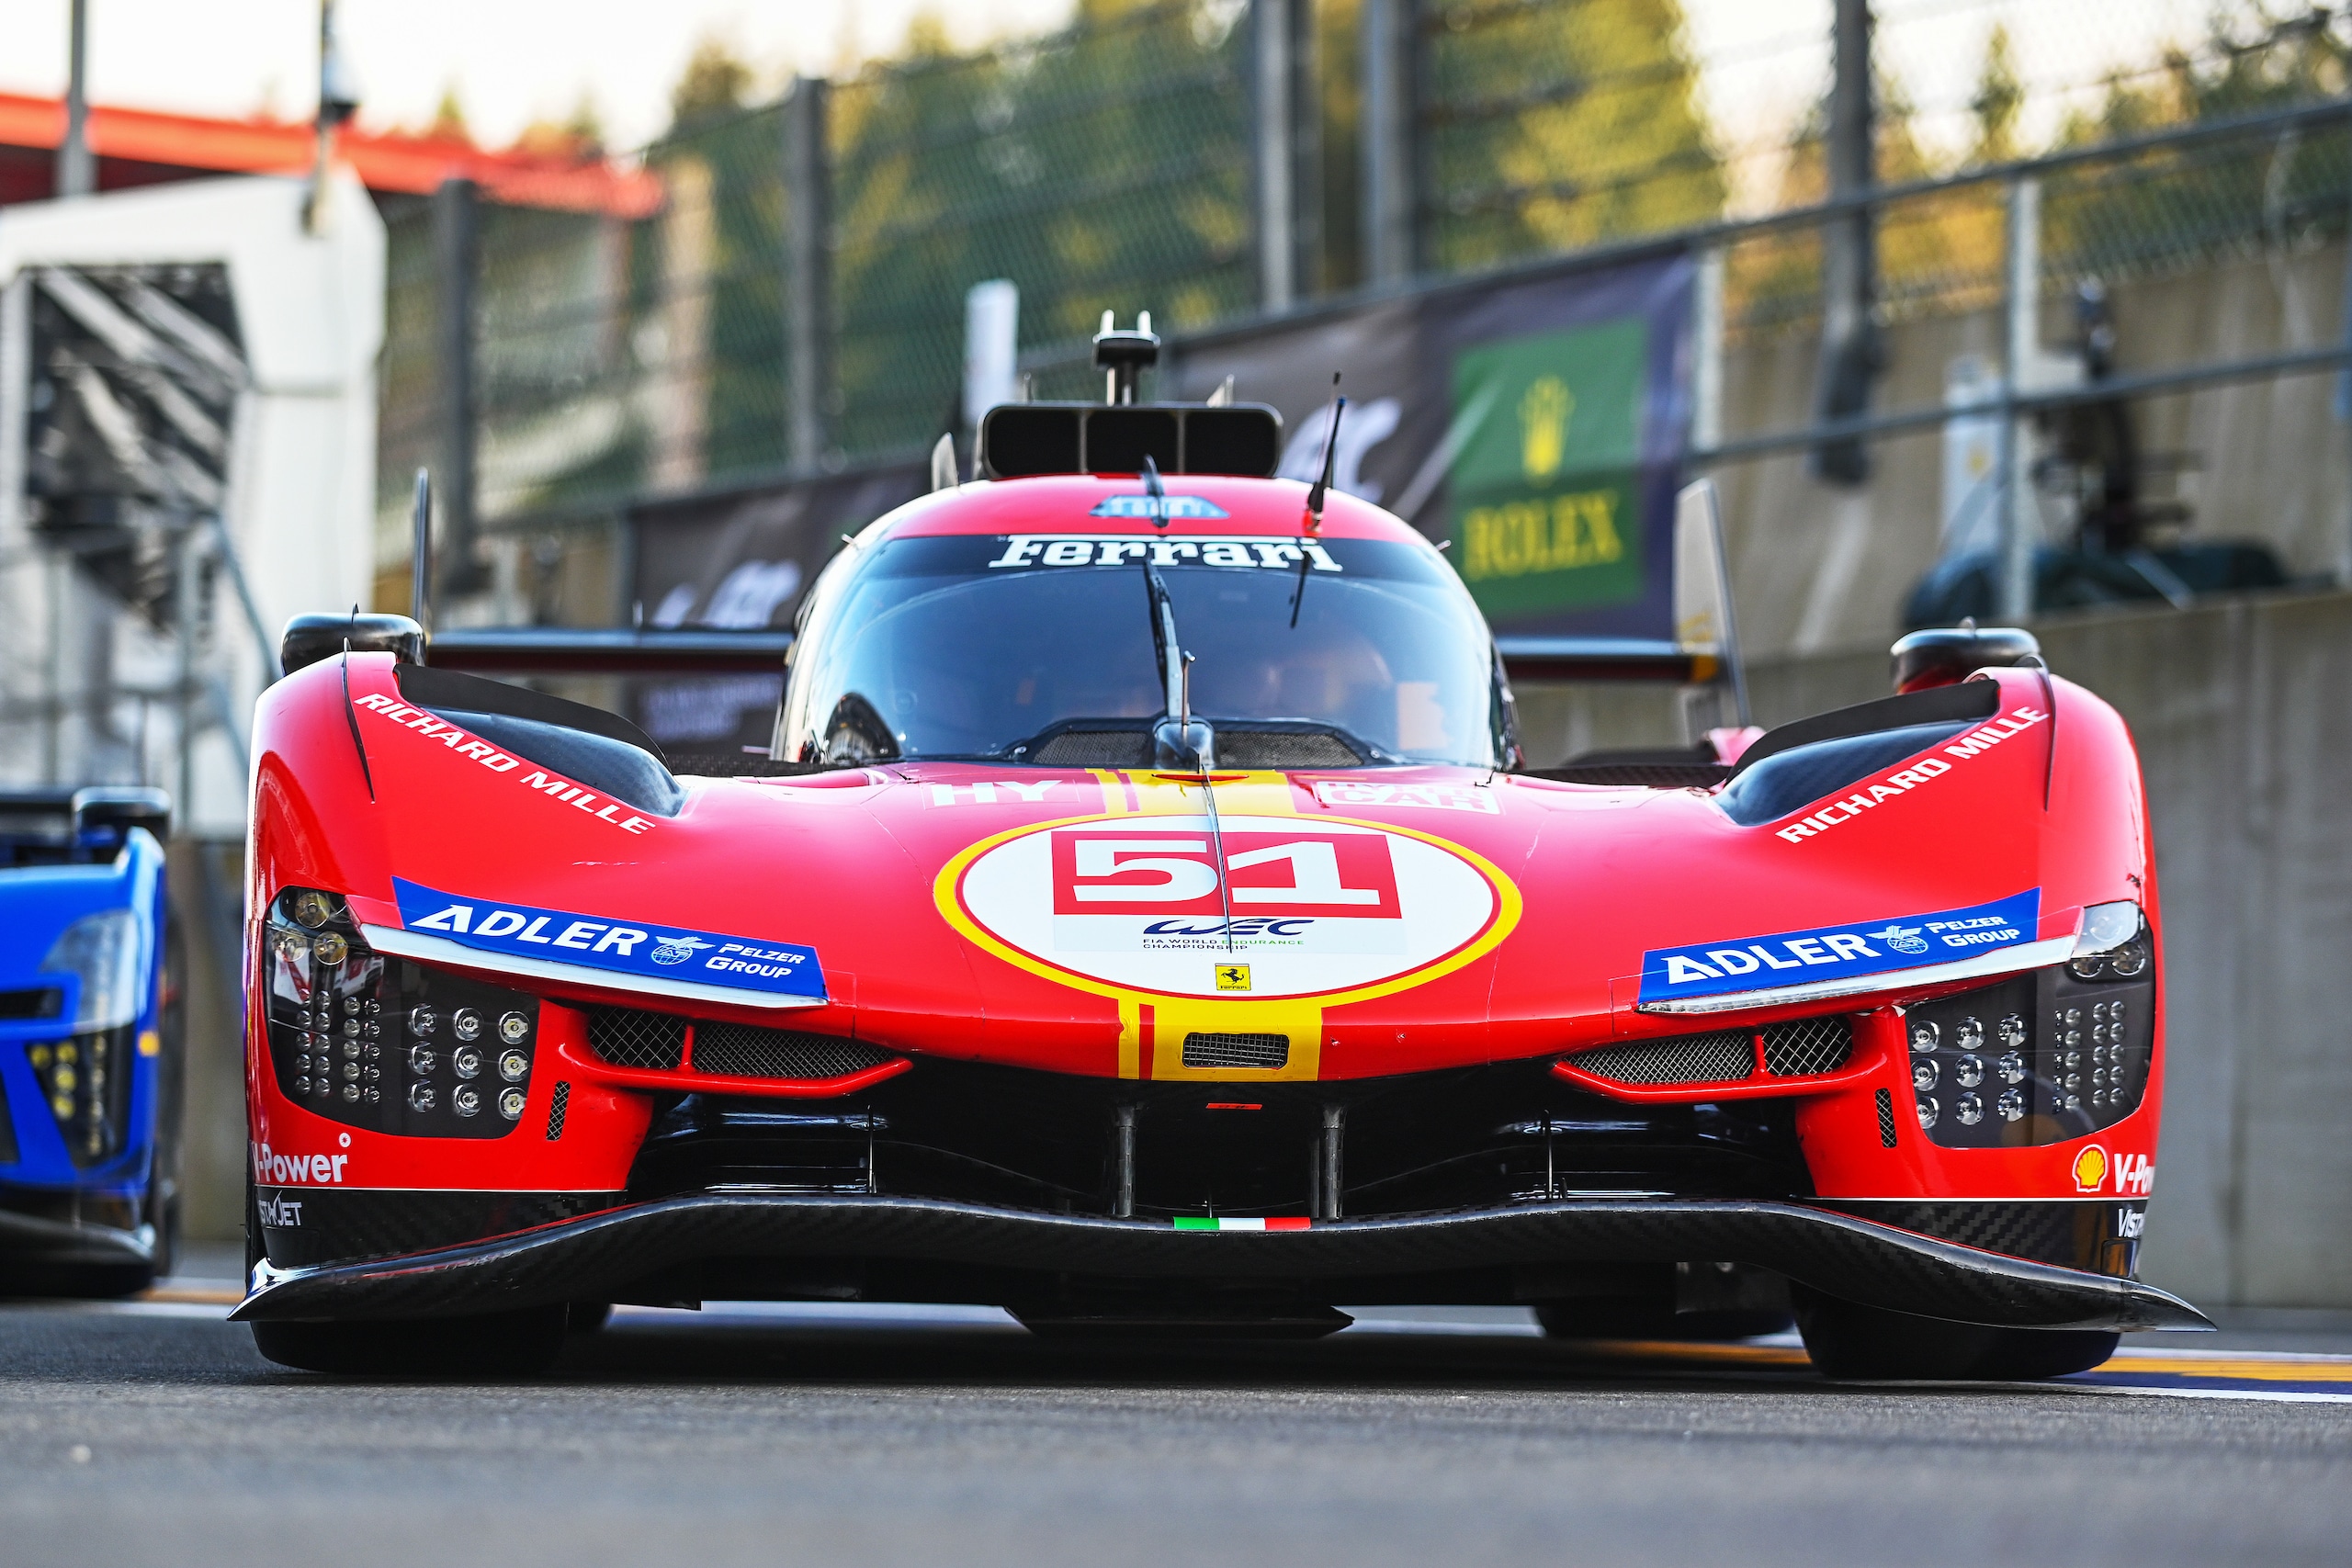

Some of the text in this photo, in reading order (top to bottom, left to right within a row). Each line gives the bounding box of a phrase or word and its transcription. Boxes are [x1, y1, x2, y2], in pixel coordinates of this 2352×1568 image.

[1460, 488, 1624, 581] ROLEX
[988, 534, 1343, 572] Ferrari
[354, 693, 656, 836] RICHARD MILLE
[1775, 705, 2050, 844] RICHARD MILLE
[931, 779, 1063, 807] HY
[1330, 789, 1487, 810] CAR
[1072, 839, 1381, 905] 51
[410, 903, 649, 957] ADLER
[1143, 919, 1315, 936] WEC
[1925, 916, 2008, 934] PELZER
[1941, 928, 2020, 947] GROUP
[705, 956, 793, 978] GROUP
[718, 942, 806, 964] PELZER
[1661, 932, 1883, 985] ADLER
